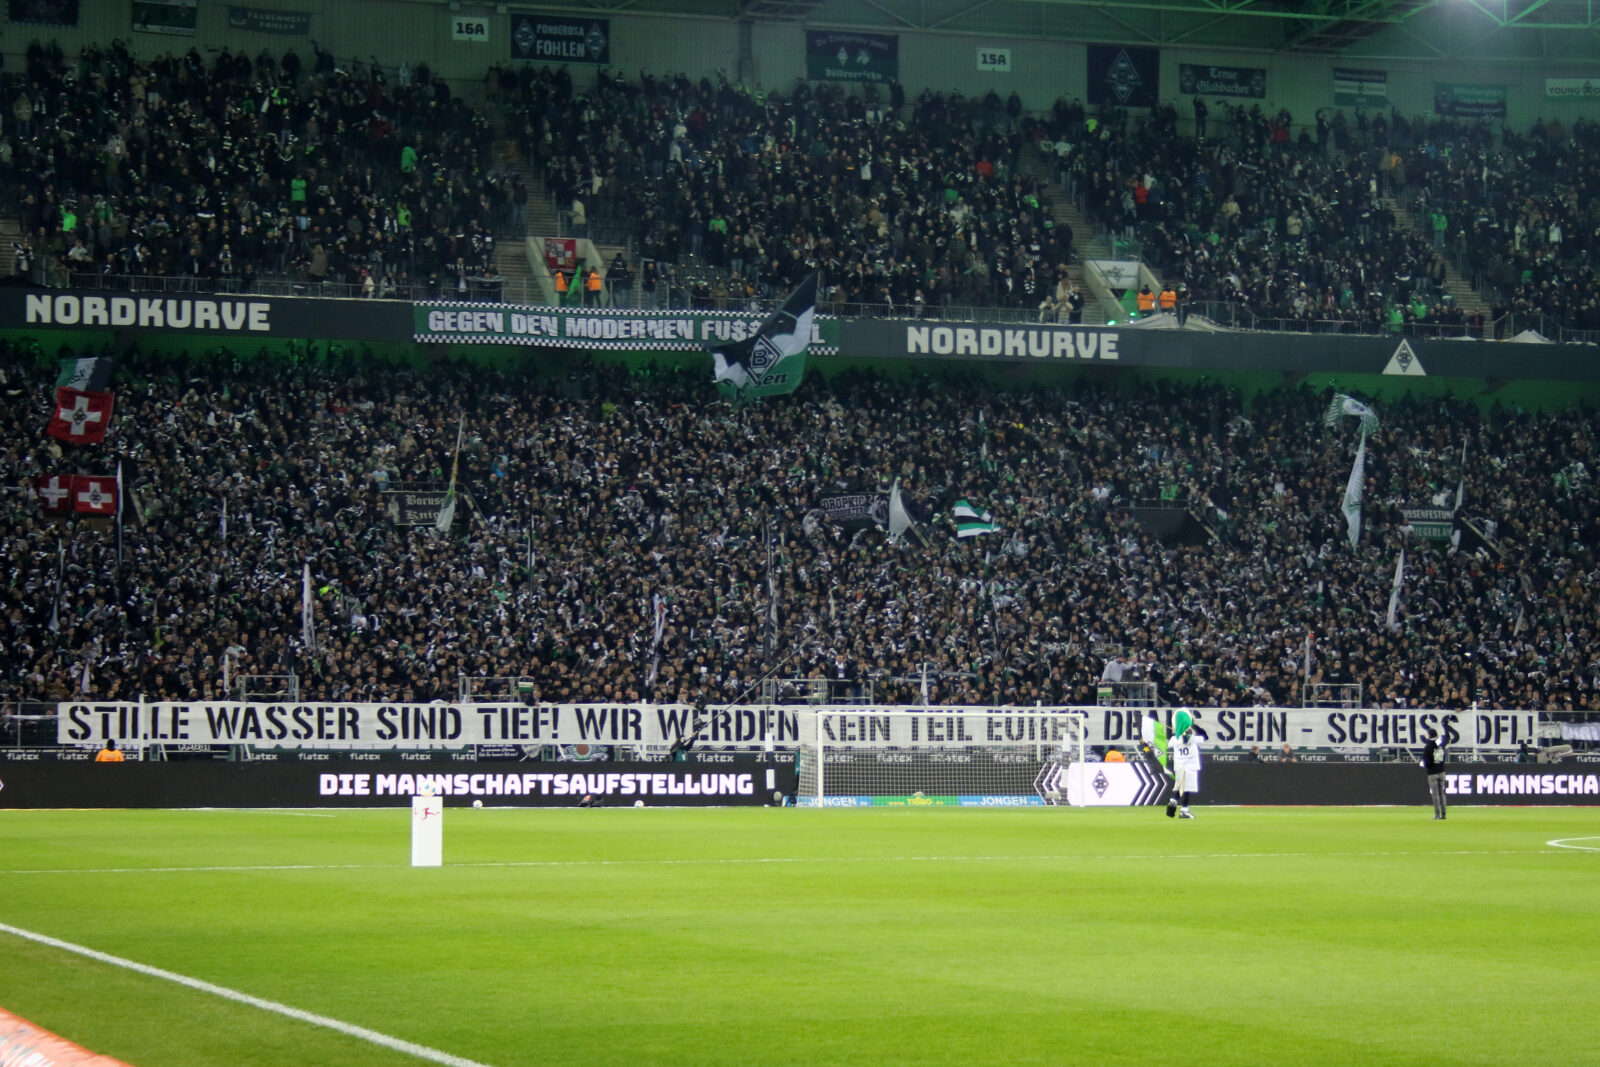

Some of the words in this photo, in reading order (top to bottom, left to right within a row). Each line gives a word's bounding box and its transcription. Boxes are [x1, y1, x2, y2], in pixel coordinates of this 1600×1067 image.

[455, 22, 485, 36] 16A
[536, 23, 585, 37] PONDEROSA
[980, 53, 1006, 66] 15A
[1549, 87, 1580, 95] YOUNG
[25, 294, 271, 331] NORDKURVE
[428, 310, 504, 333] GEGEN
[511, 313, 559, 337] DEN
[565, 316, 694, 340] MODERNEN
[907, 326, 1119, 360] NORDKURVE
[68, 705, 190, 740] STILLE
[205, 705, 360, 741] WASSER
[376, 705, 462, 741] SIND
[477, 707, 560, 741] TIEF!
[575, 707, 642, 742] WIR
[657, 708, 799, 742] WERDEN
[905, 709, 973, 742] TEIL
[1216, 710, 1287, 742] SEIN
[1328, 712, 1460, 745] SCHEISS
[1475, 714, 1535, 745] DFL!
[57, 752, 89, 761] flatex
[298, 752, 330, 761] flatex
[350, 752, 381, 761] flatex
[400, 752, 432, 761] flatex
[1178, 747, 1189, 757] 10
[696, 753, 734, 762] flatex
[756, 753, 794, 762] fltex
[1212, 754, 1240, 762] flatex
[1300, 754, 1327, 762] flatex
[1344, 754, 1370, 762] flatex
[319, 773, 371, 795] DIE
[1476, 774, 1600, 795] MANNSCHA
